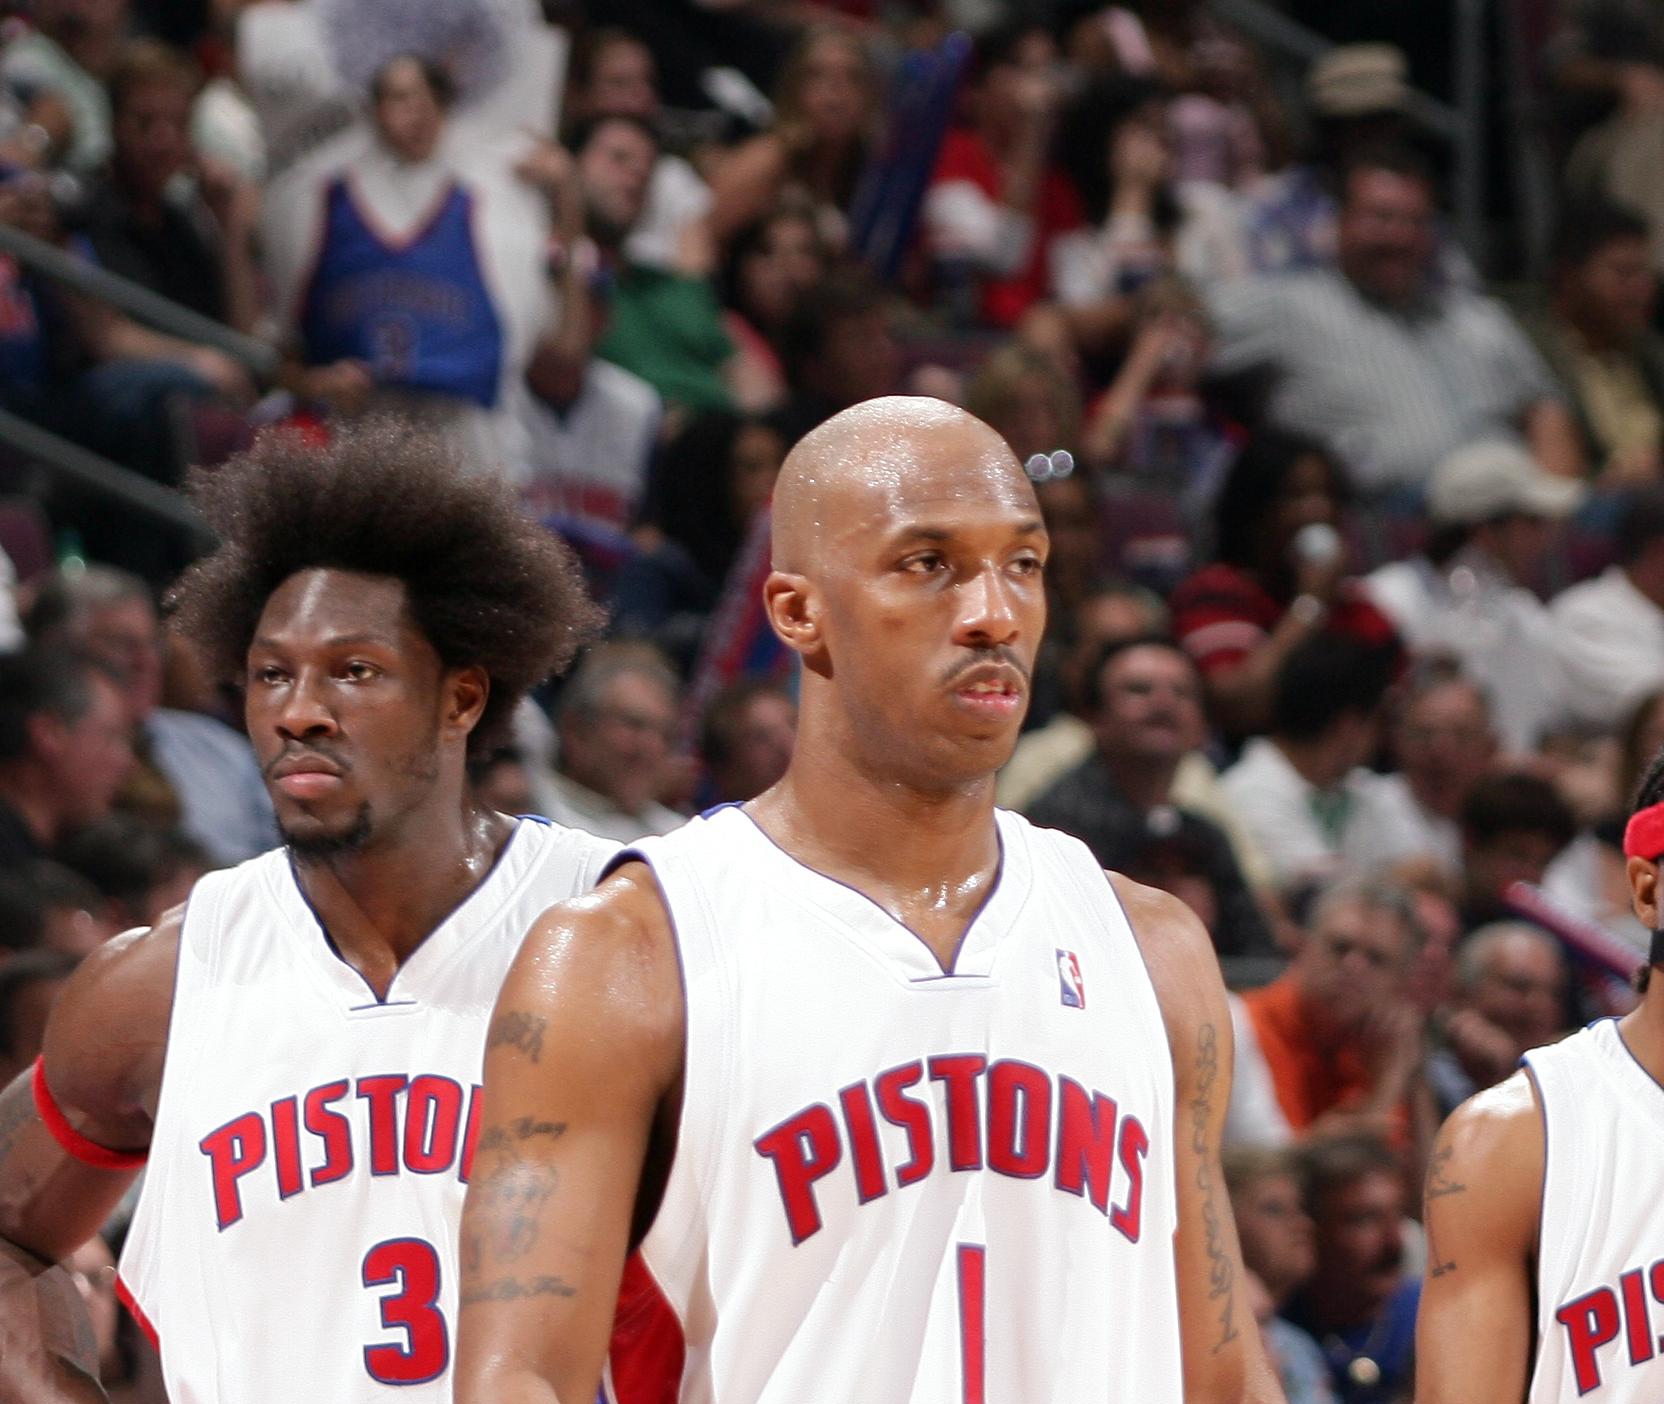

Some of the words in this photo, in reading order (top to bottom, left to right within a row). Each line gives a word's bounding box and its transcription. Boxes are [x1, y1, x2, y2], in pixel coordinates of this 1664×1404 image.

[199, 1072, 485, 1232] PISTO
[754, 1052, 1149, 1247] PISTONS
[363, 1237, 450, 1387] 3
